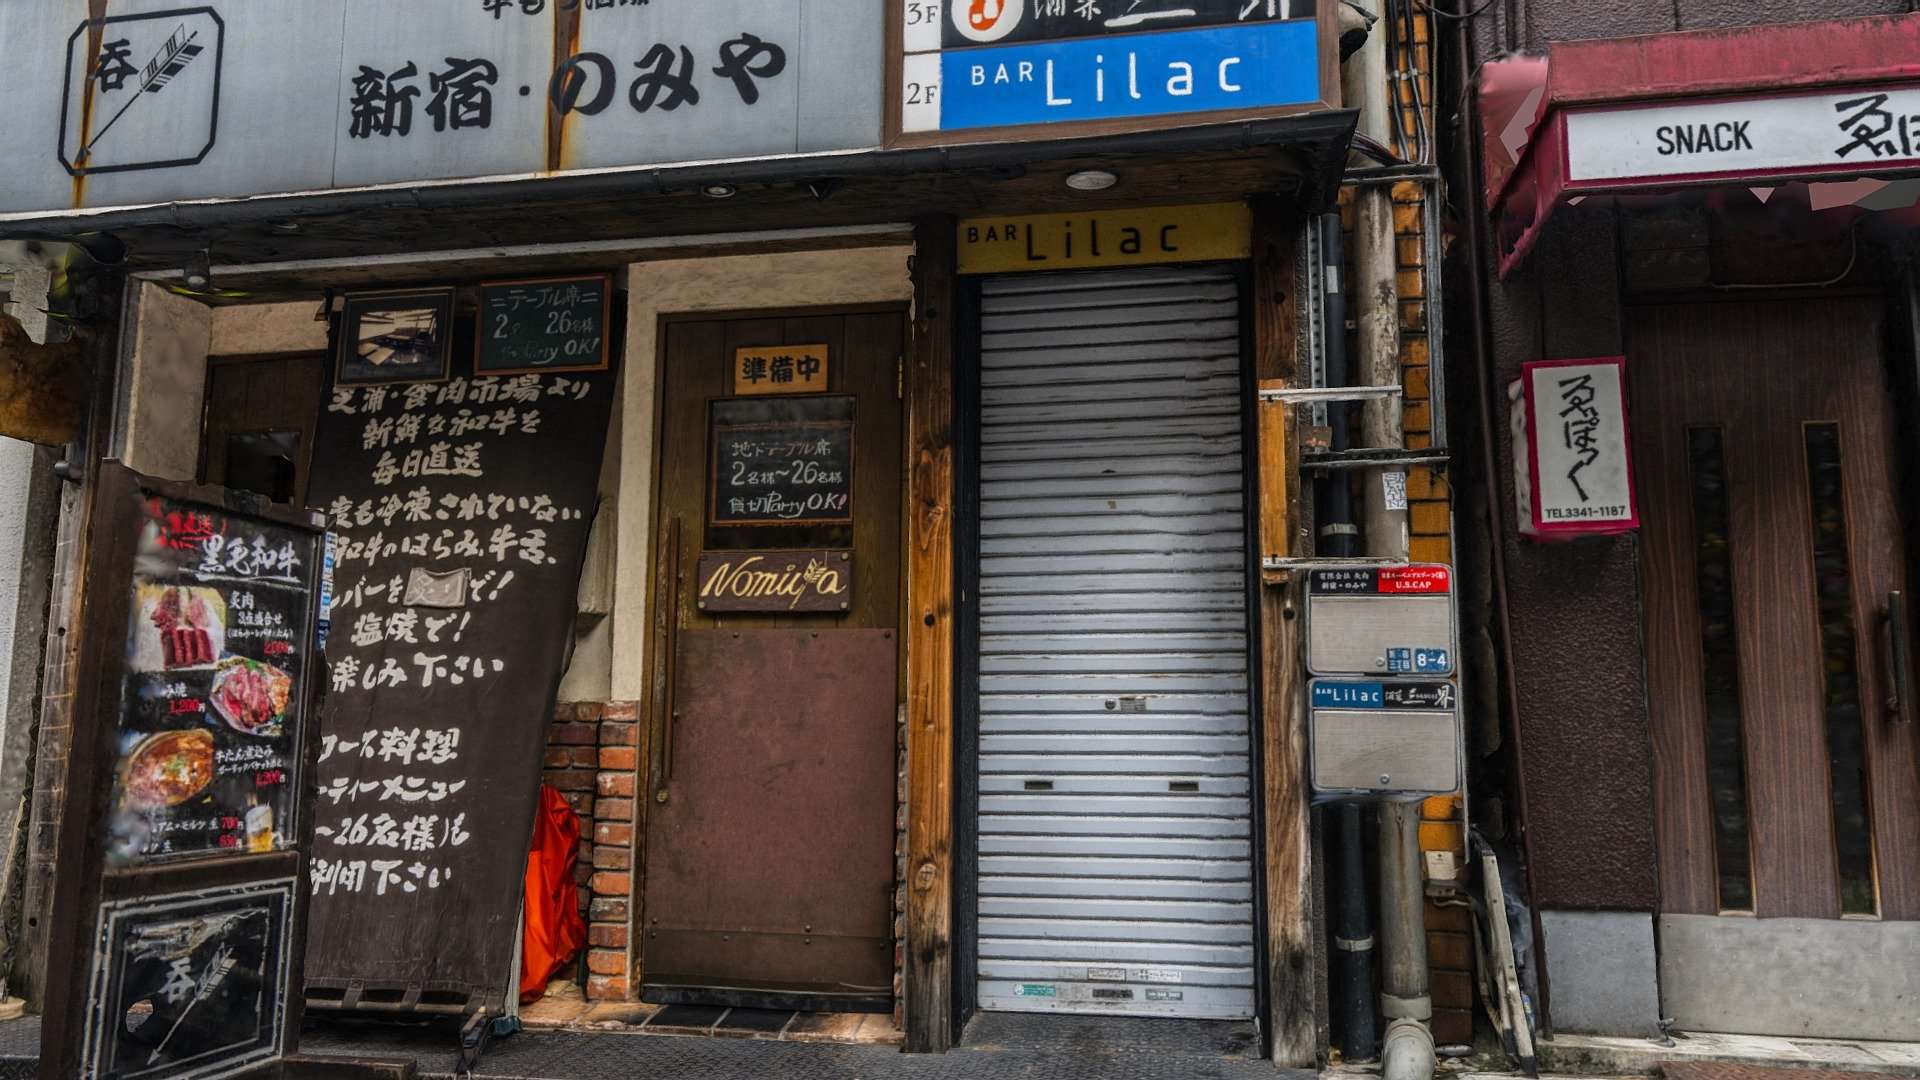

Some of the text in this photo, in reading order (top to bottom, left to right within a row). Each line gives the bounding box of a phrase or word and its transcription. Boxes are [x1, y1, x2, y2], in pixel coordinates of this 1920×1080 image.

[905, 2, 937, 26] 3F
[94, 38, 139, 94] 呑
[348, 32, 787, 139] 新宿・のみや
[971, 52, 1242, 106] BAR Lilac
[906, 82, 937, 106] 2F
[1656, 119, 1753, 156] SNACK
[967, 218, 1180, 262] BAR Lilac
[741, 354, 821, 384] 準備中
[361, 407, 542, 450] 新鮮な和牛を
[372, 442, 484, 485] 毎日直送
[1417, 652, 1447, 667] 8-4
[1333, 688, 1380, 702] Lilac
